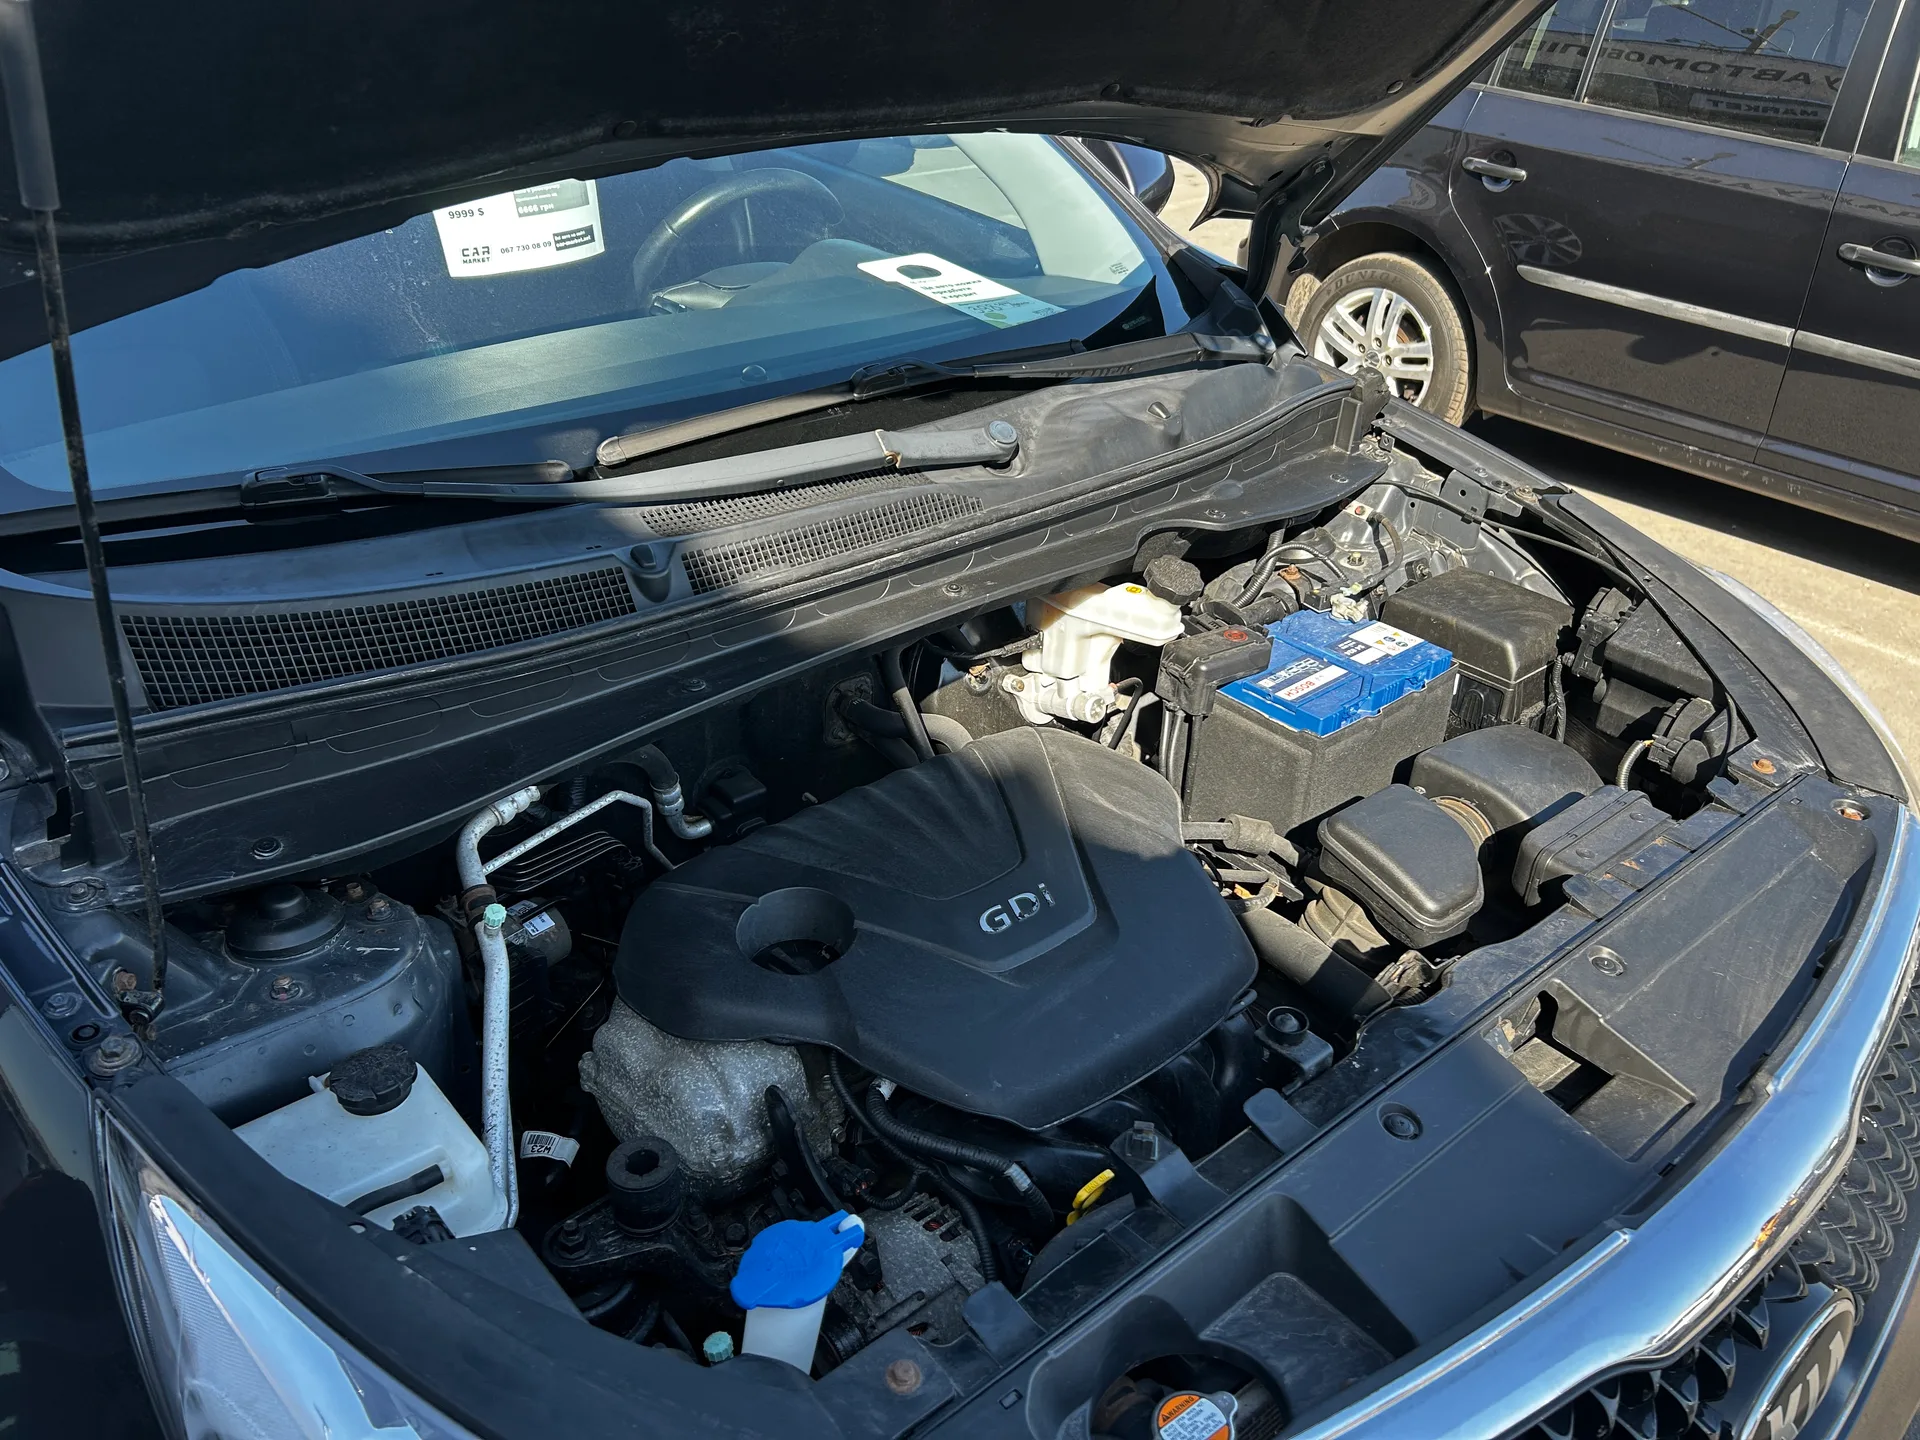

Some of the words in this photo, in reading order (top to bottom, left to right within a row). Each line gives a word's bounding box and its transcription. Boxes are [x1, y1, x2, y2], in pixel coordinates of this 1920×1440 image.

[448, 209, 474, 219] 9999
[461, 246, 490, 257] CAR
[516, 244, 530, 252] 730
[1335, 270, 1402, 290] DUNLOP
[1284, 680, 1316, 698] BOSCH
[530, 1144, 552, 1155] W23
[1167, 1396, 1195, 1417] WARNING
